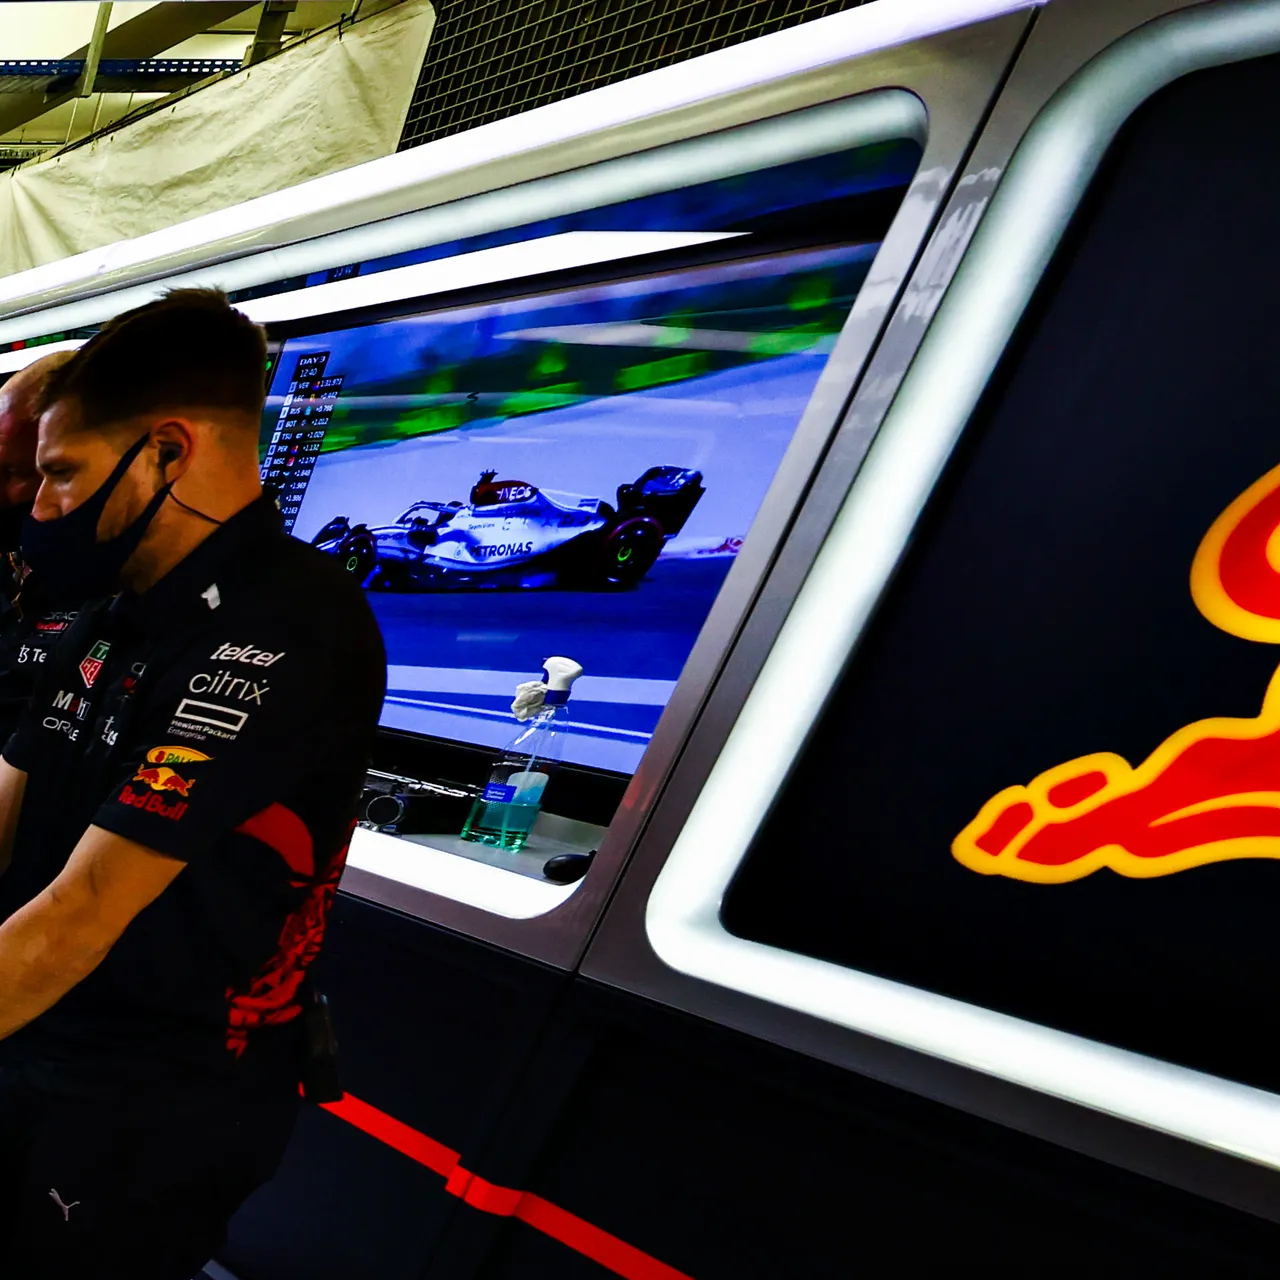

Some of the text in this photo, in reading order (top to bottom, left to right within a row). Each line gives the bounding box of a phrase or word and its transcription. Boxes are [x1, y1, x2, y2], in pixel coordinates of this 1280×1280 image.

[300, 357, 319, 366] DAY
[285, 420, 297, 428] BOT
[210, 642, 285, 667] telcel
[189, 670, 270, 706] citrix
[167, 727, 207, 741] Enterprise
[171, 719, 238, 741] Hewlett Packard
[146, 792, 189, 820] Bull
